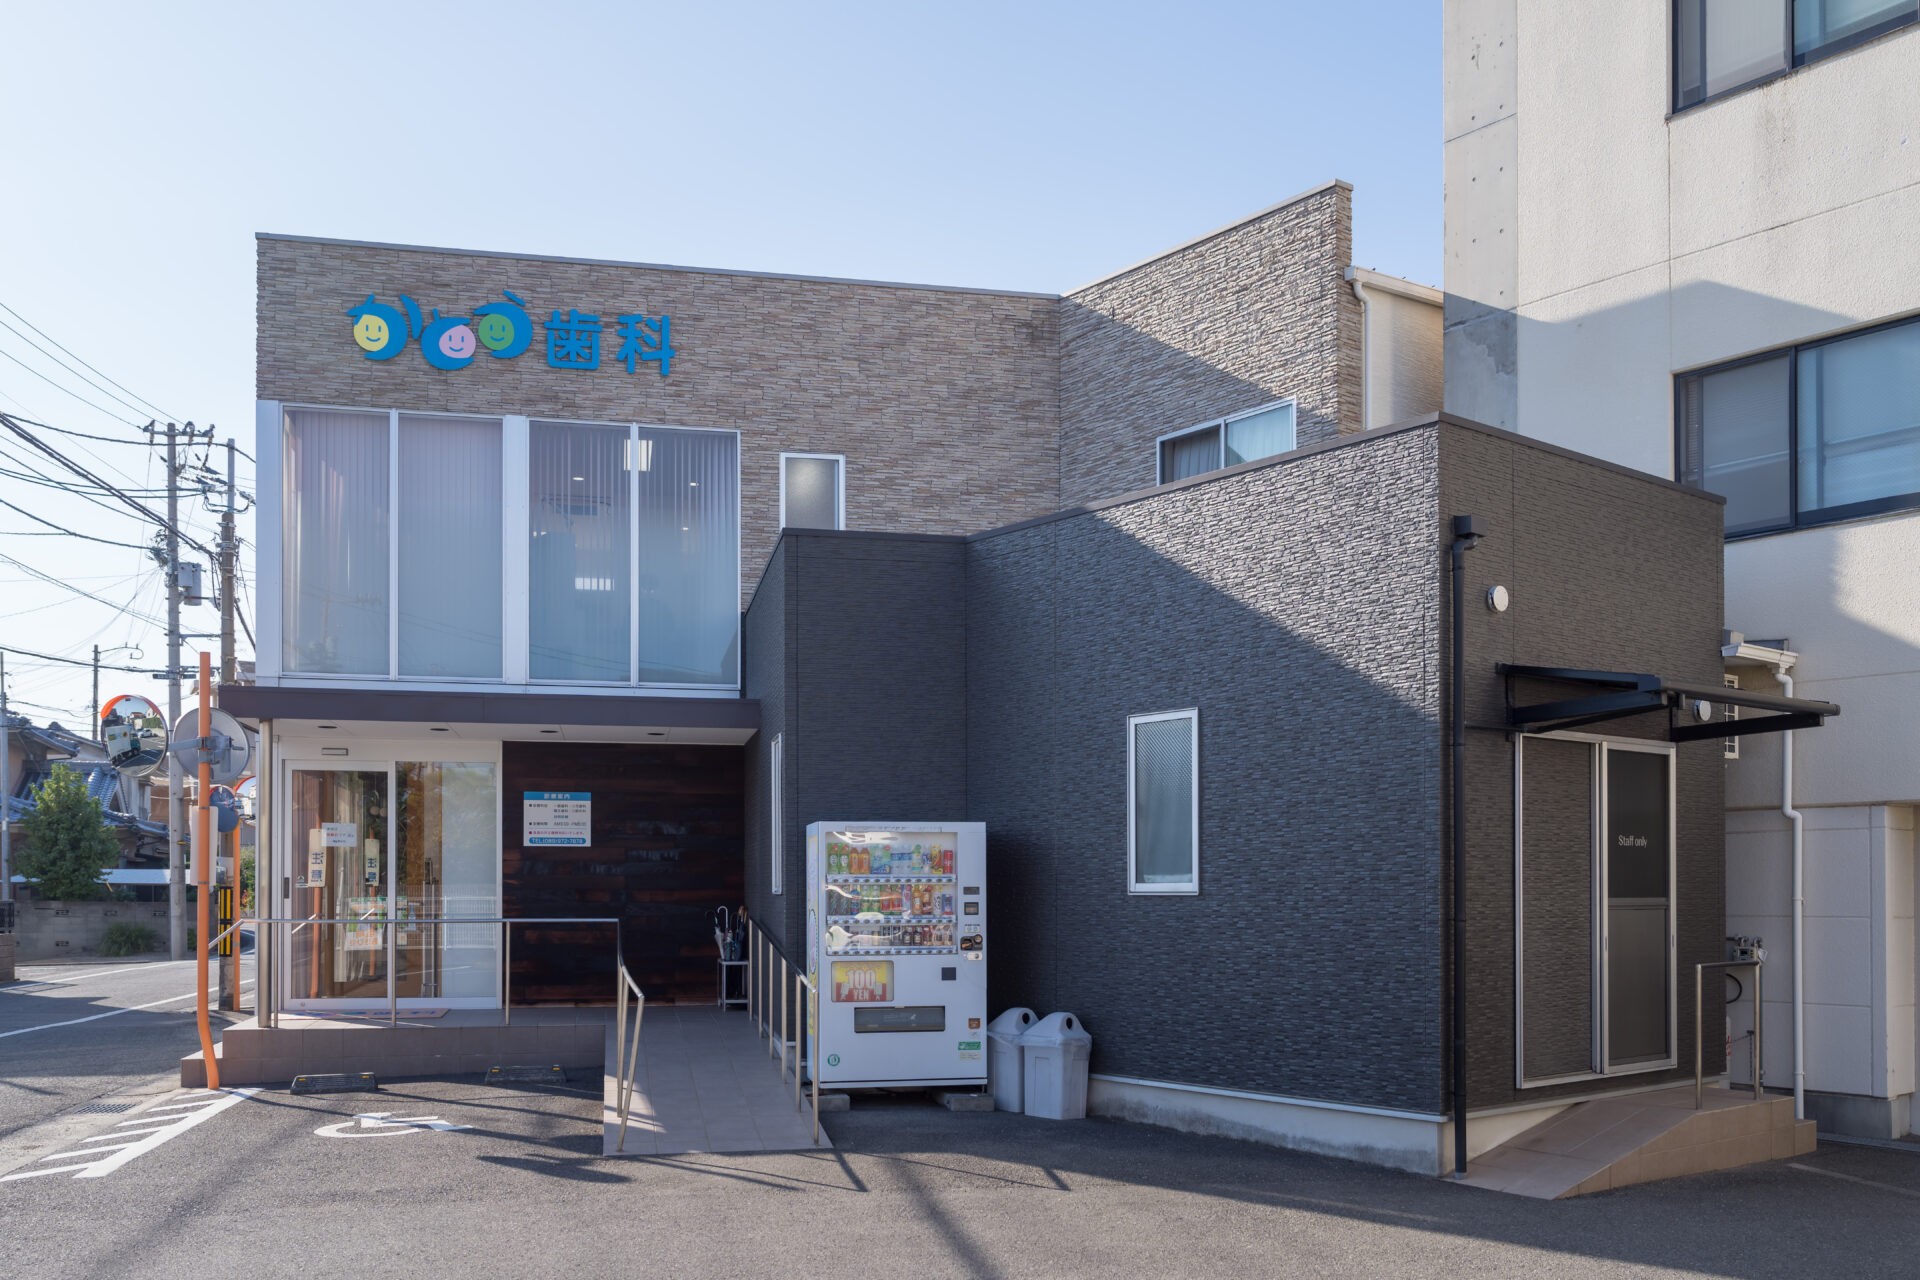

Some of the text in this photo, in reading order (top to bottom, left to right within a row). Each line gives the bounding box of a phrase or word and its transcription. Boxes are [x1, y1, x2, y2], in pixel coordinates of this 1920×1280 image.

[1618, 834, 1648, 848] Staff only
[847, 969, 876, 989] 100
[854, 989, 869, 1000] YEN
